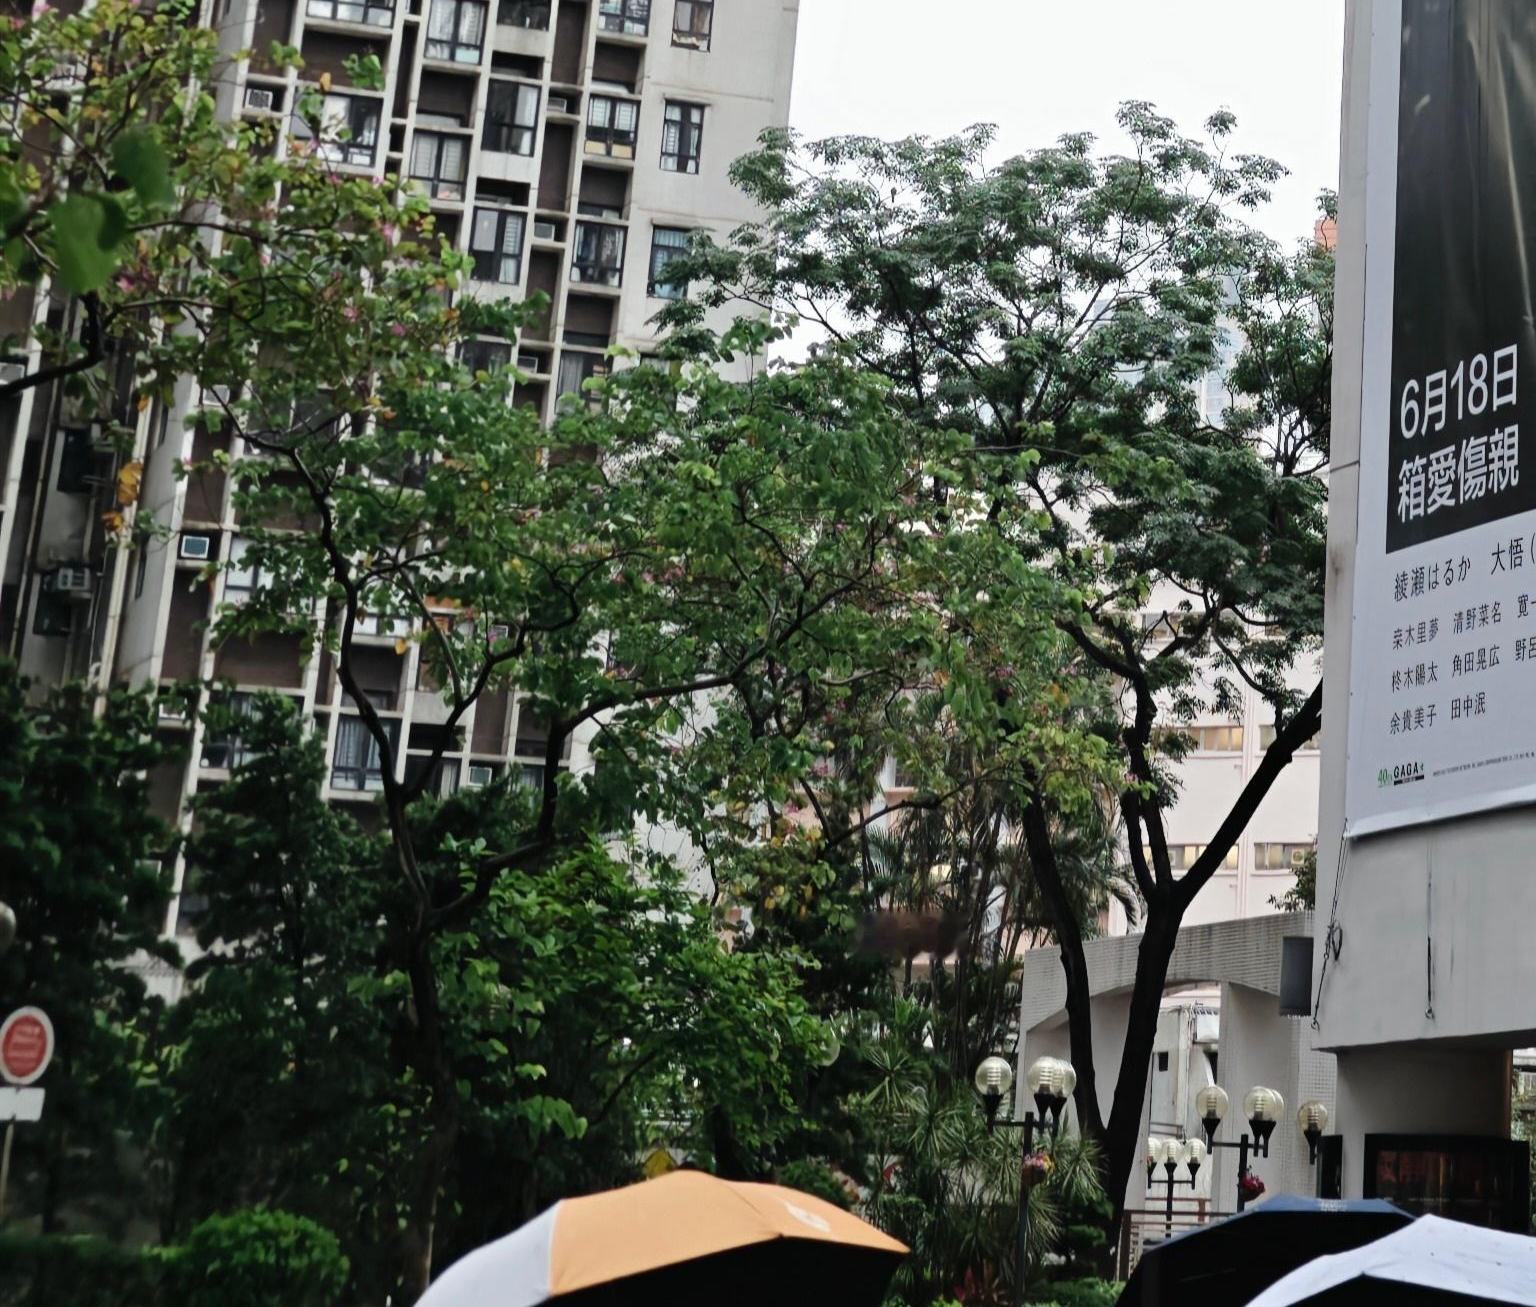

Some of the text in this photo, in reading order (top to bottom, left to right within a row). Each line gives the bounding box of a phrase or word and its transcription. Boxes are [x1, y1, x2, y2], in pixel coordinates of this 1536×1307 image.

[1400, 343, 1518, 439] 6月18日
[1398, 423, 1520, 523] 箱愛傷親
[1393, 555, 1471, 602] 綾瀬はるか
[1453, 600, 1503, 634] 清野菜名
[1389, 692, 1486, 736] 余貴美子 田中泯
[1394, 762, 1419, 779] GAGA
